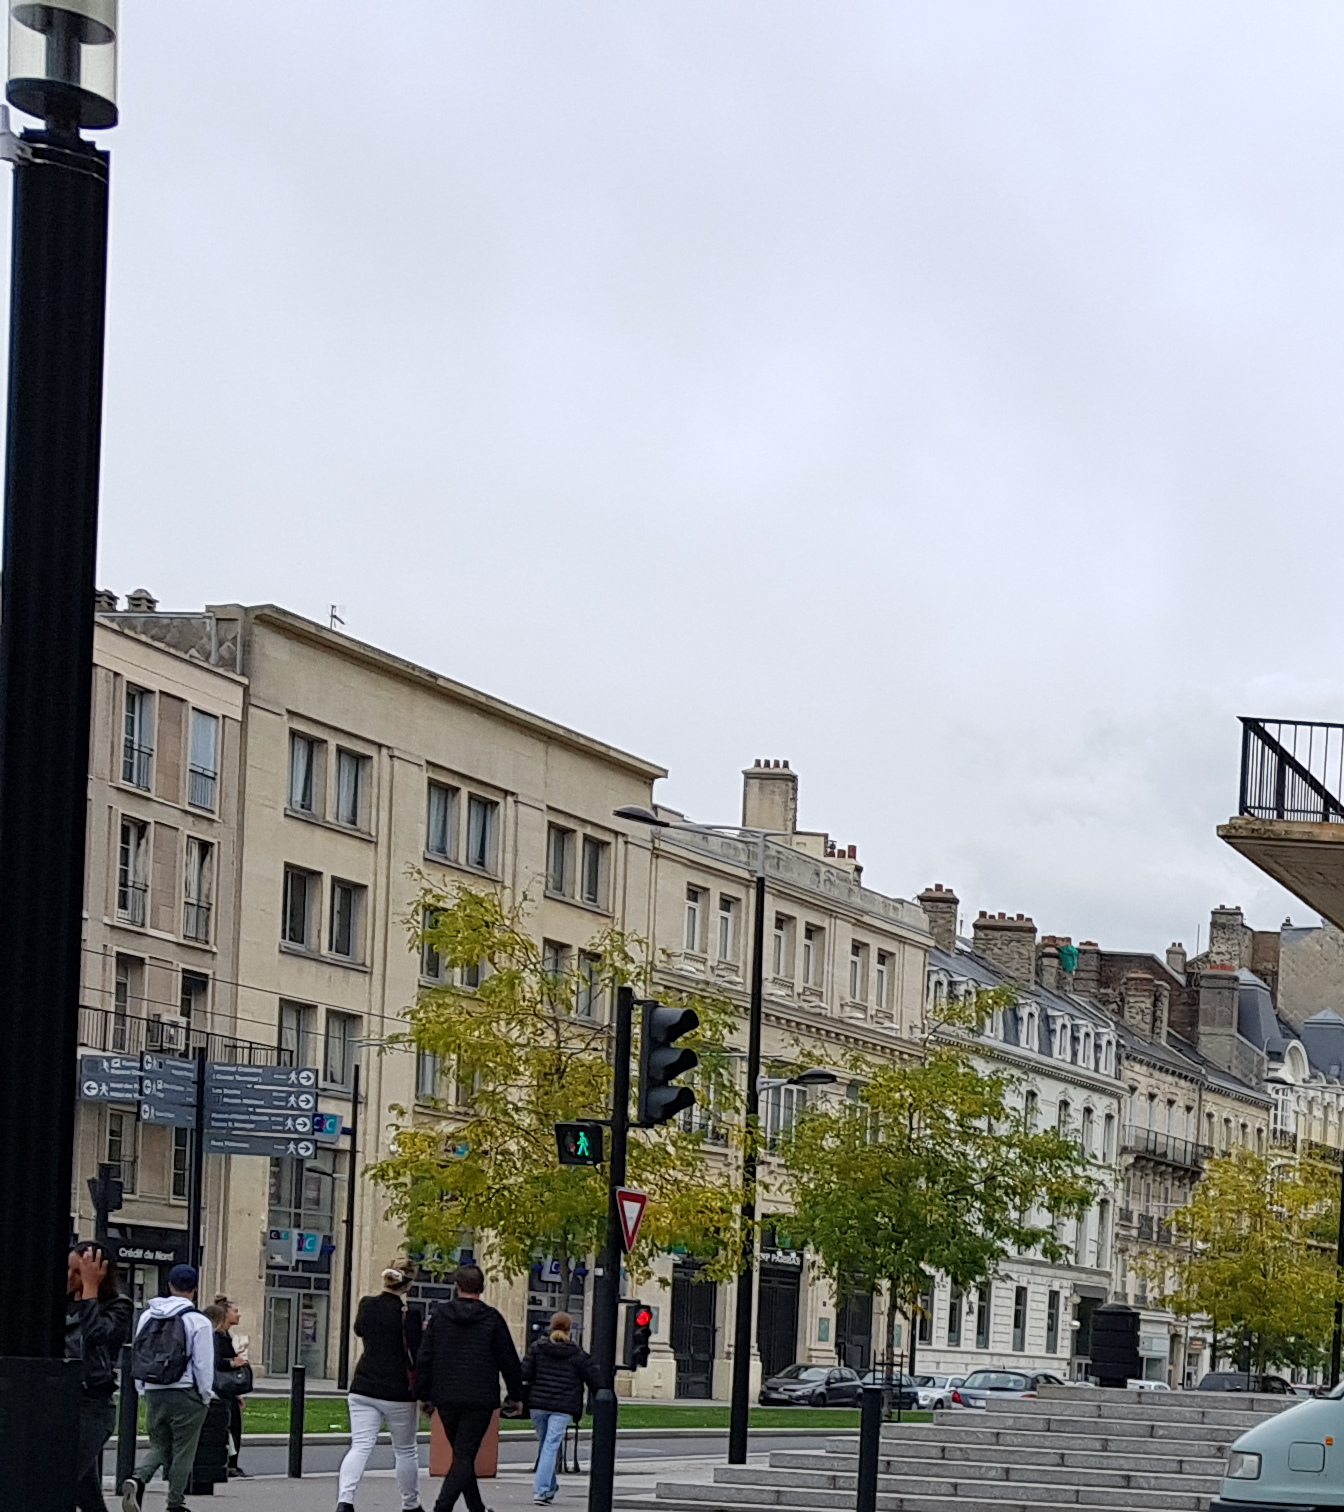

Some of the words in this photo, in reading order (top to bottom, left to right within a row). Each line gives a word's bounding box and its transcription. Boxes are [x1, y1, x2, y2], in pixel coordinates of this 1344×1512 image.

[118, 1247, 143, 1258] Crédit
[144, 1249, 154, 1260] du
[155, 1250, 174, 1261] Nord
